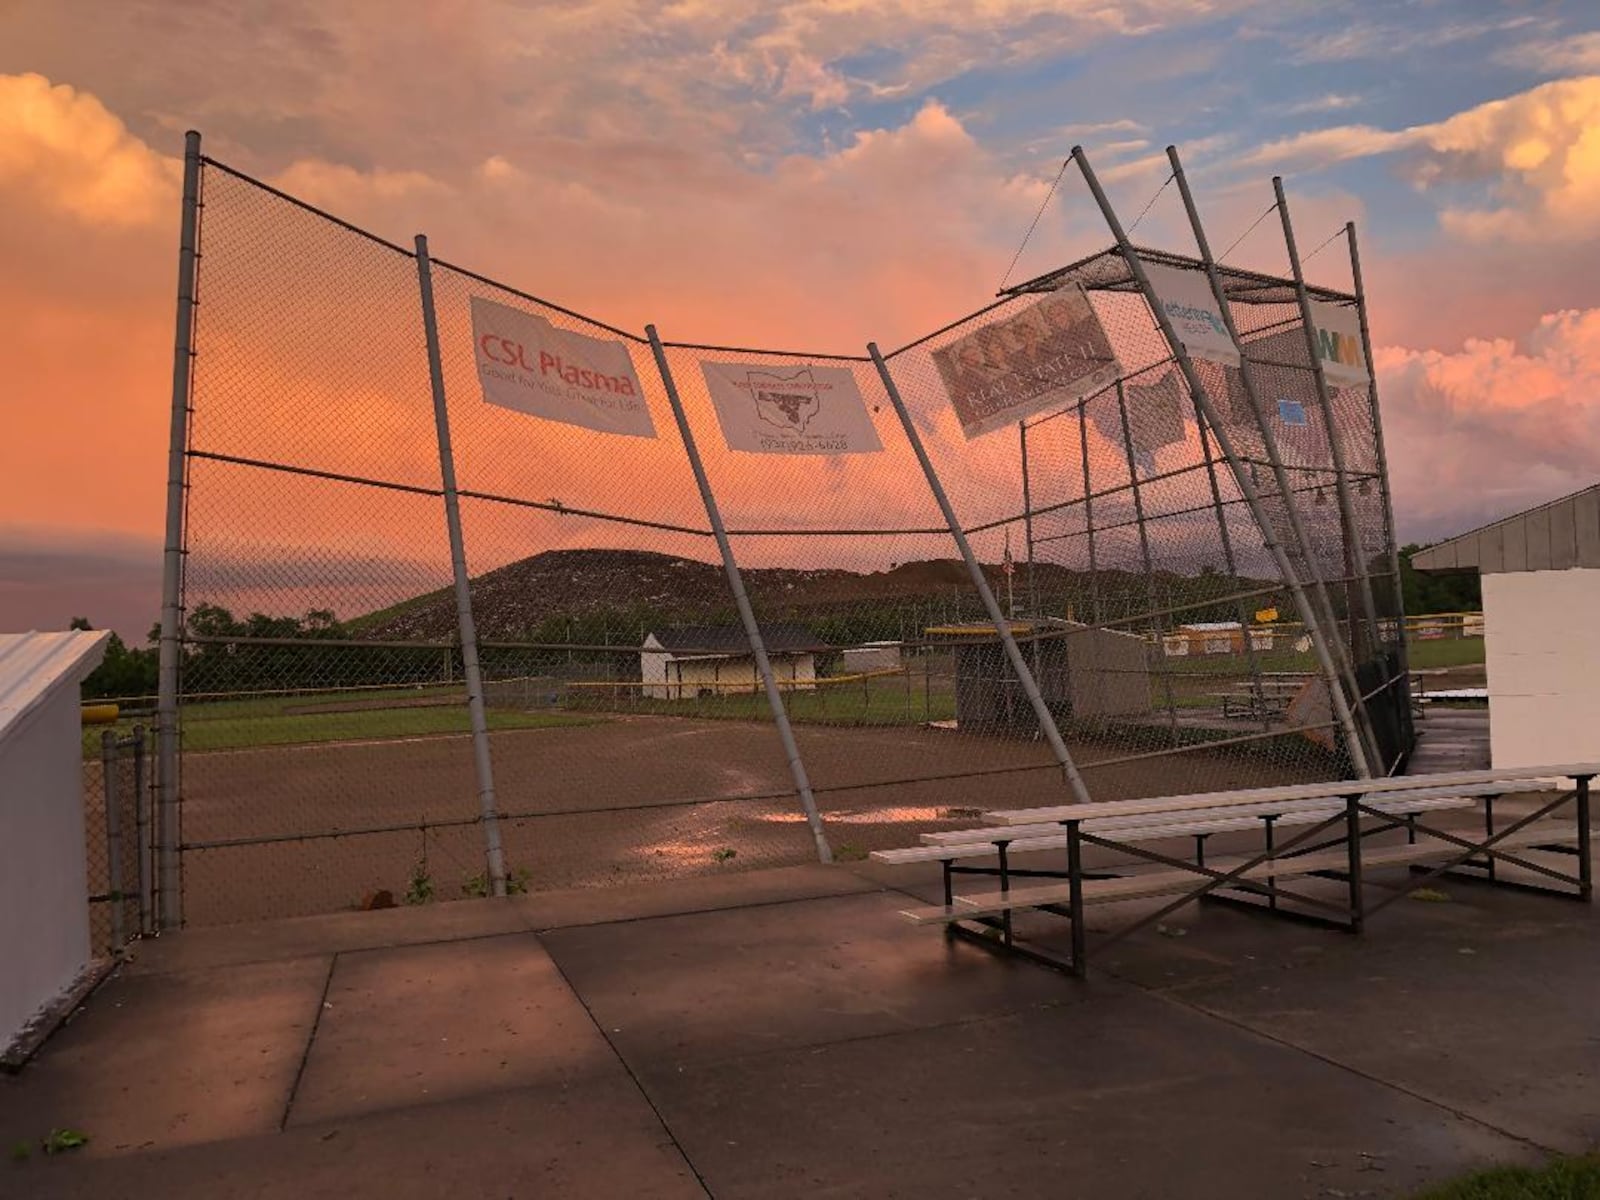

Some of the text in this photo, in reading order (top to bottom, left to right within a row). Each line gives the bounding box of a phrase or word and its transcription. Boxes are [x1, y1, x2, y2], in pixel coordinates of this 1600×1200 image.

[479, 333, 636, 397] CSL Plasma
[1313, 327, 1362, 368] WM
